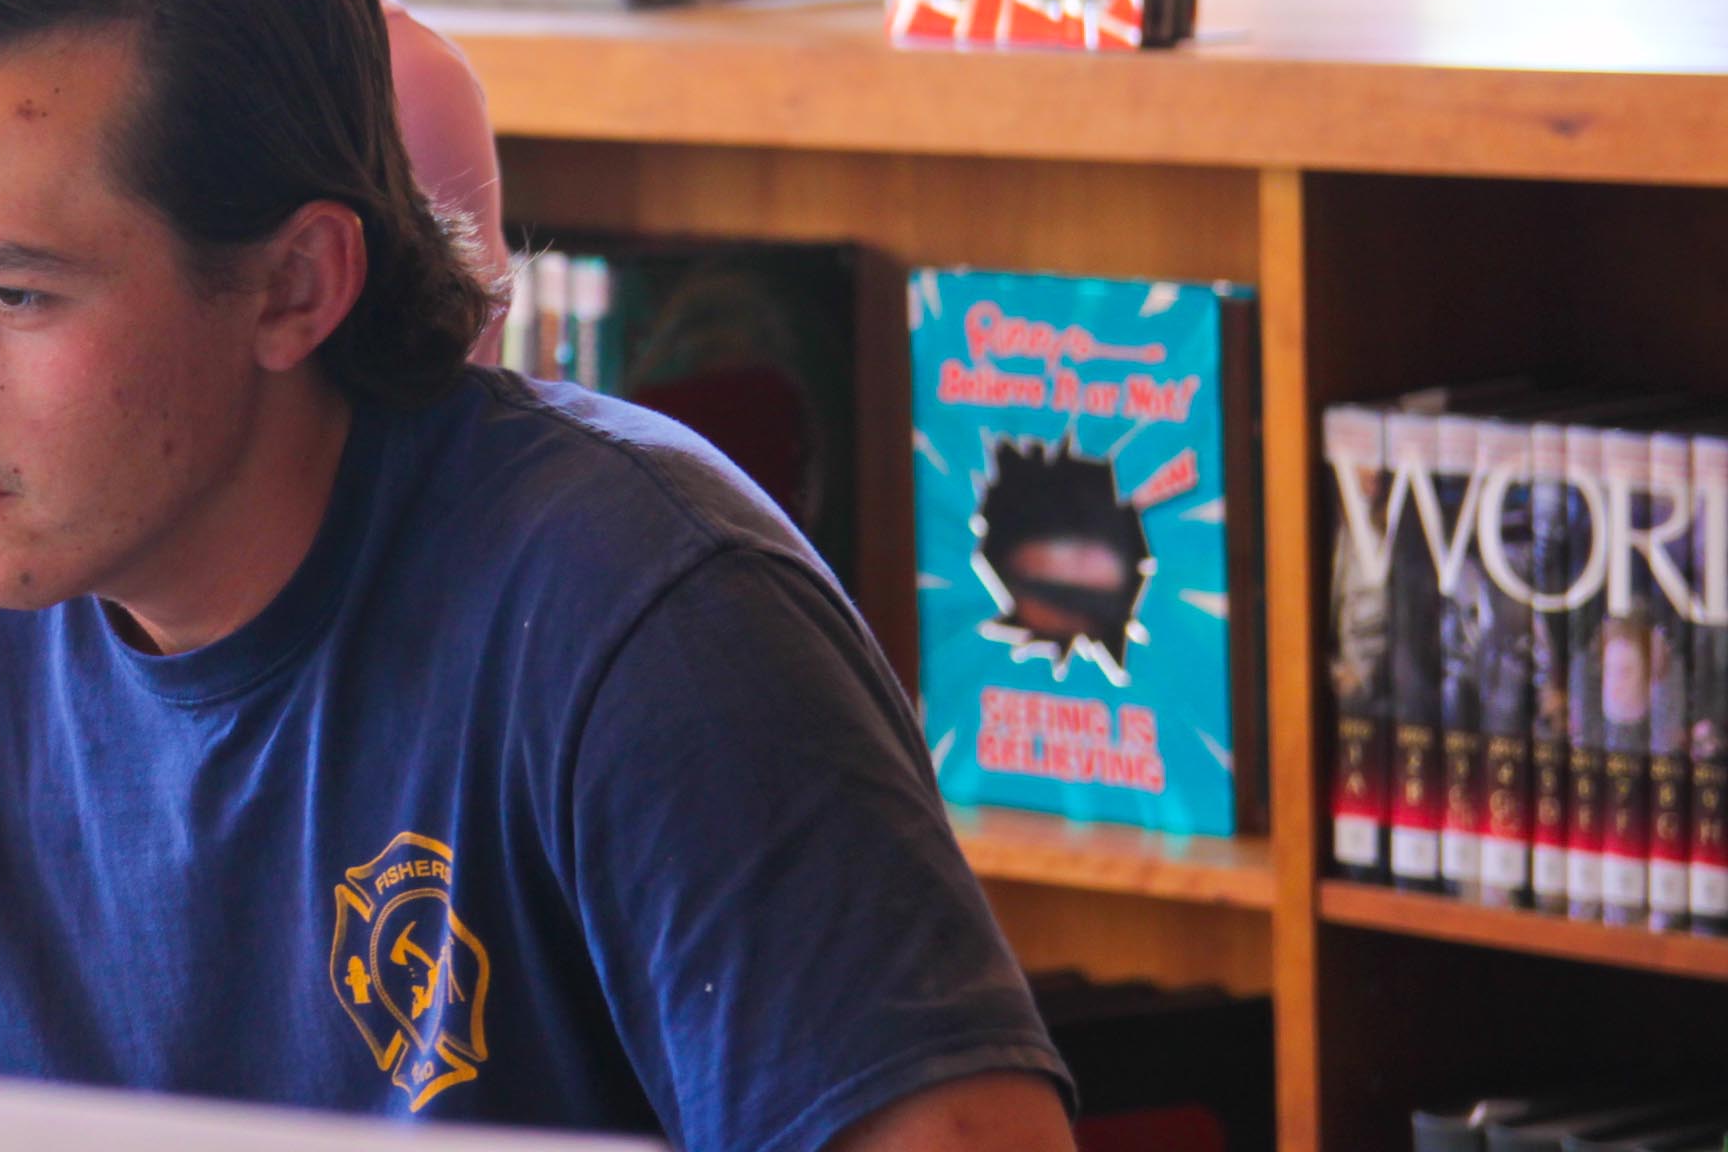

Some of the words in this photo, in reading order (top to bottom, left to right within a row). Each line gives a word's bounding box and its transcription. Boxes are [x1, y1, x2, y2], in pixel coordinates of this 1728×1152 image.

[937, 358, 1044, 408] Believe
[1083, 380, 1120, 416] or
[1123, 373, 1200, 423] Not!
[980, 685, 1112, 738] SEEING
[1118, 703, 1156, 748] IS
[976, 727, 1166, 794] BELIEVING
